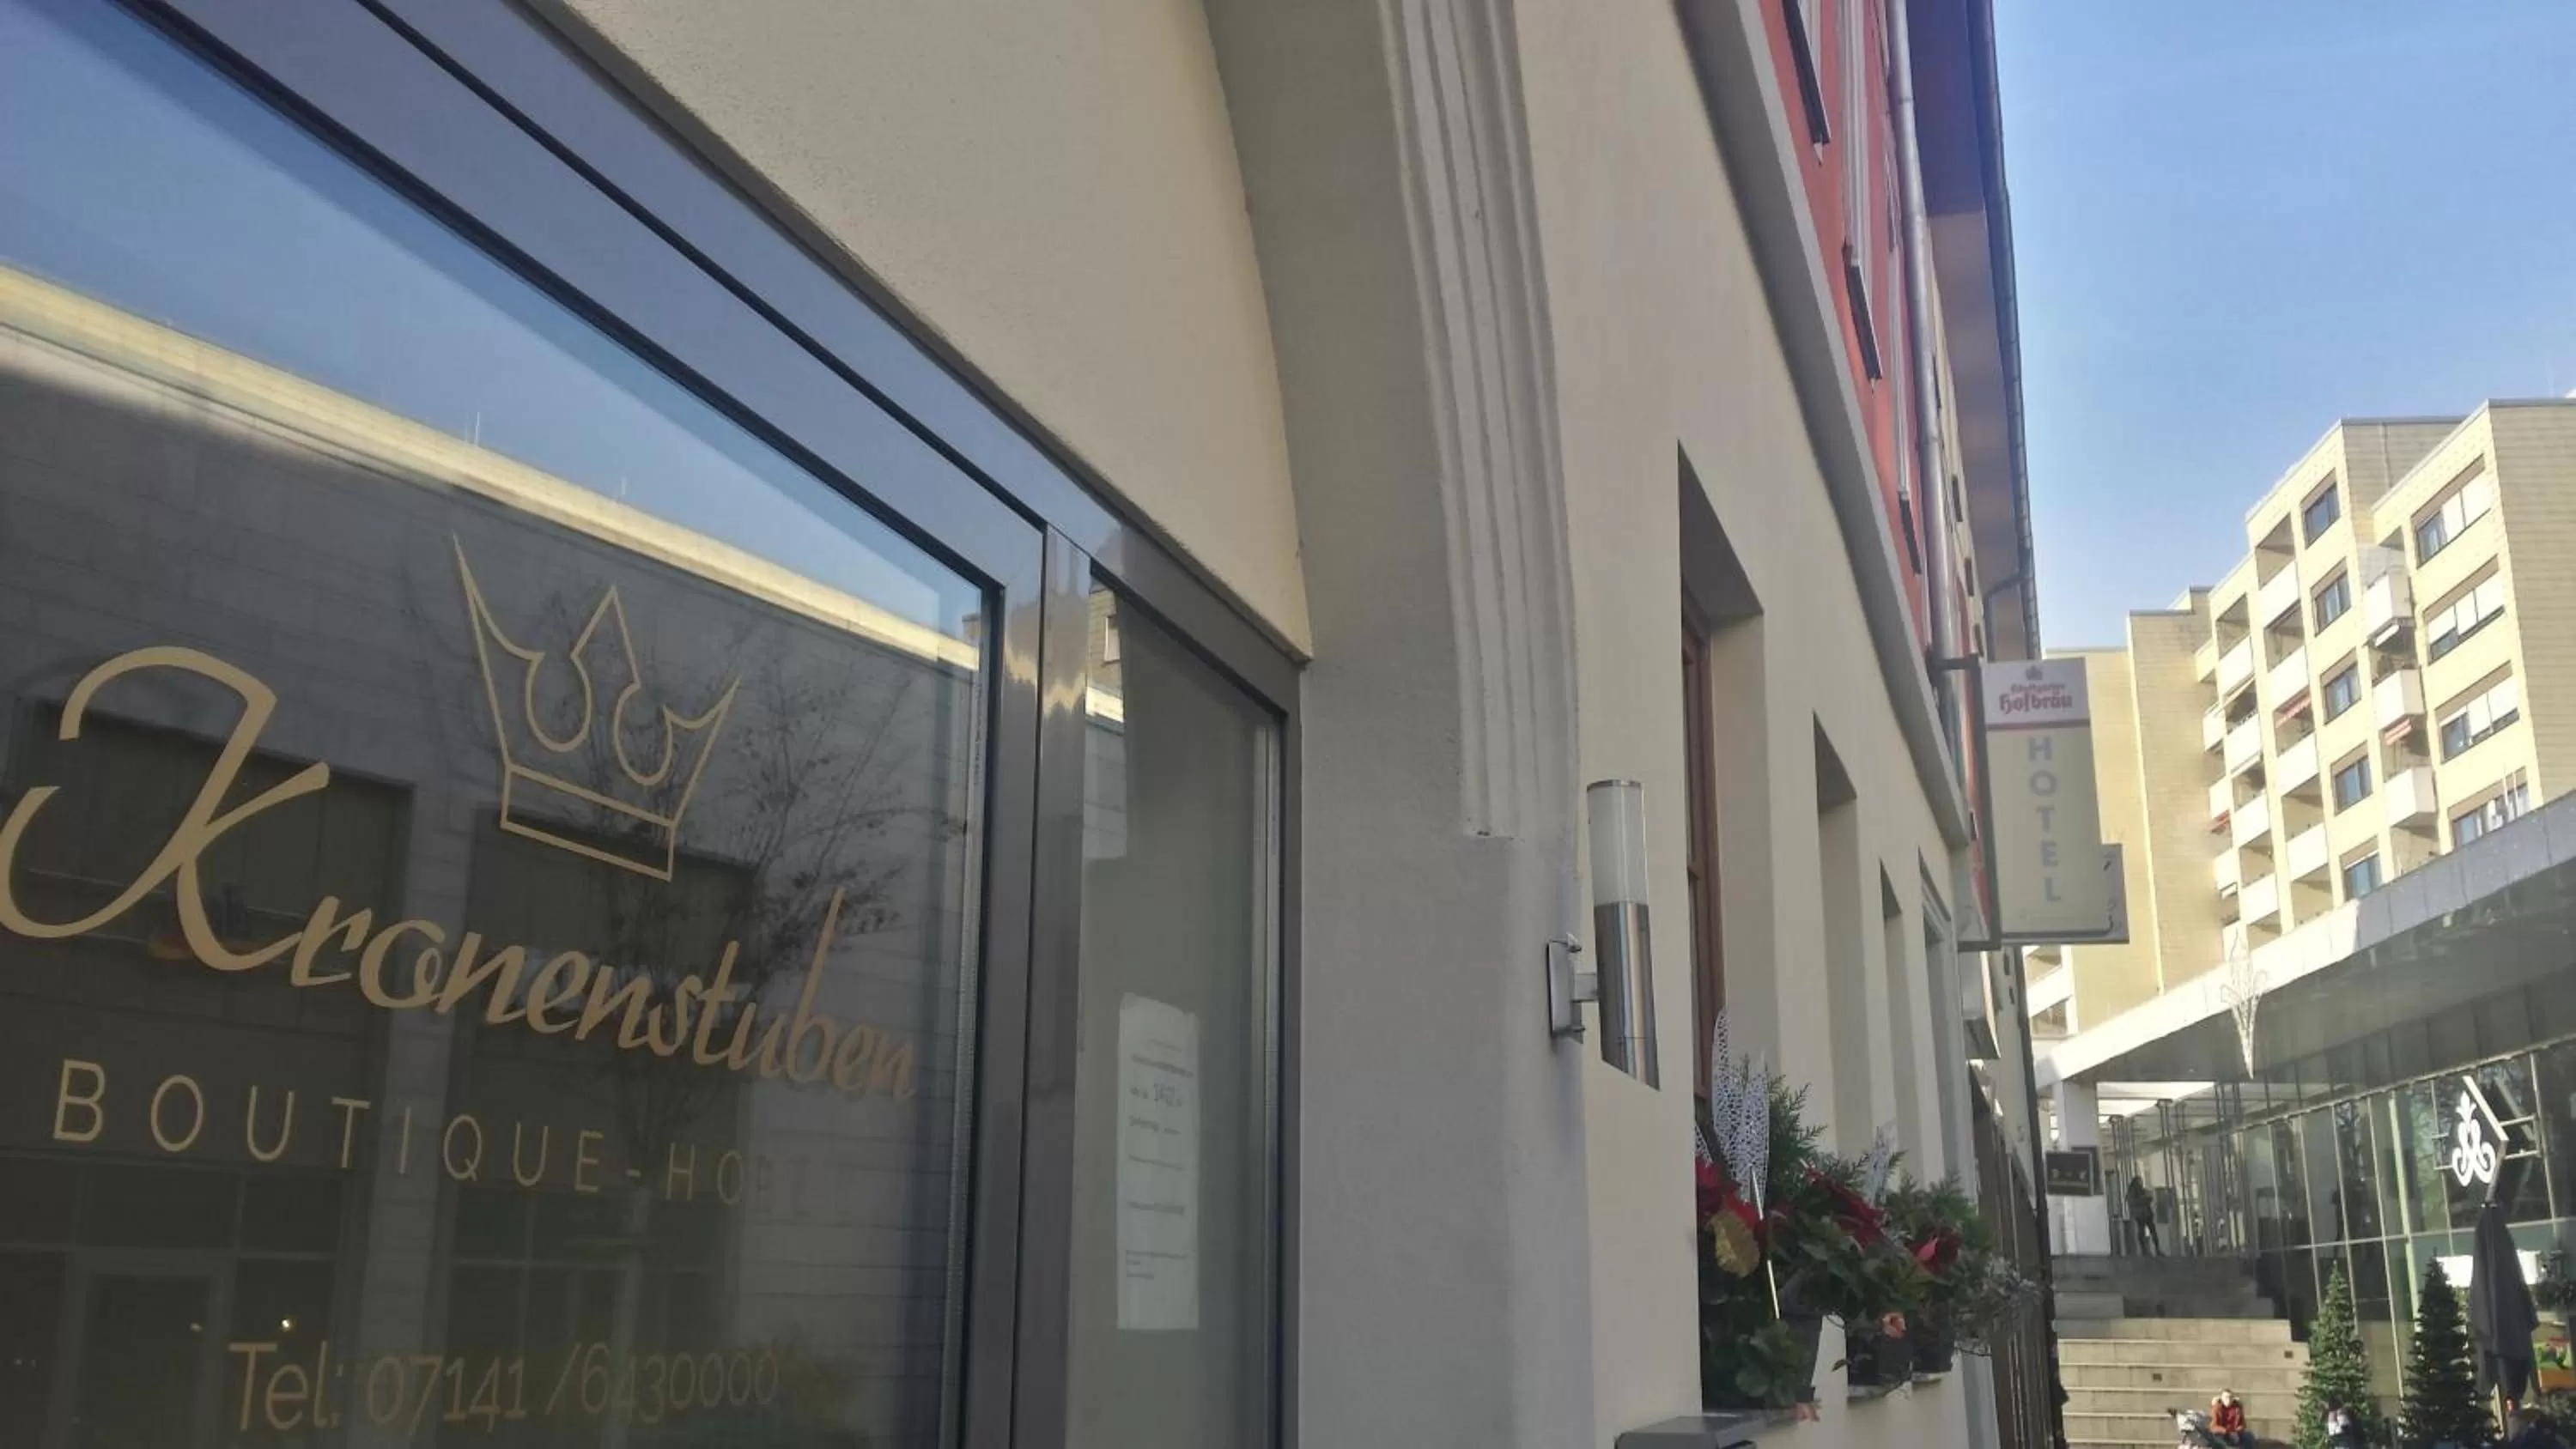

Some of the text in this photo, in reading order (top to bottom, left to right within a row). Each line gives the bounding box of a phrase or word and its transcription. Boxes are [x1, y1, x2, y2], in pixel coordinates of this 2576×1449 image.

[0, 646, 917, 1098] Kronenstuben
[2027, 736, 2062, 902] HOTEL
[364, 1352, 527, 1438] 07141
